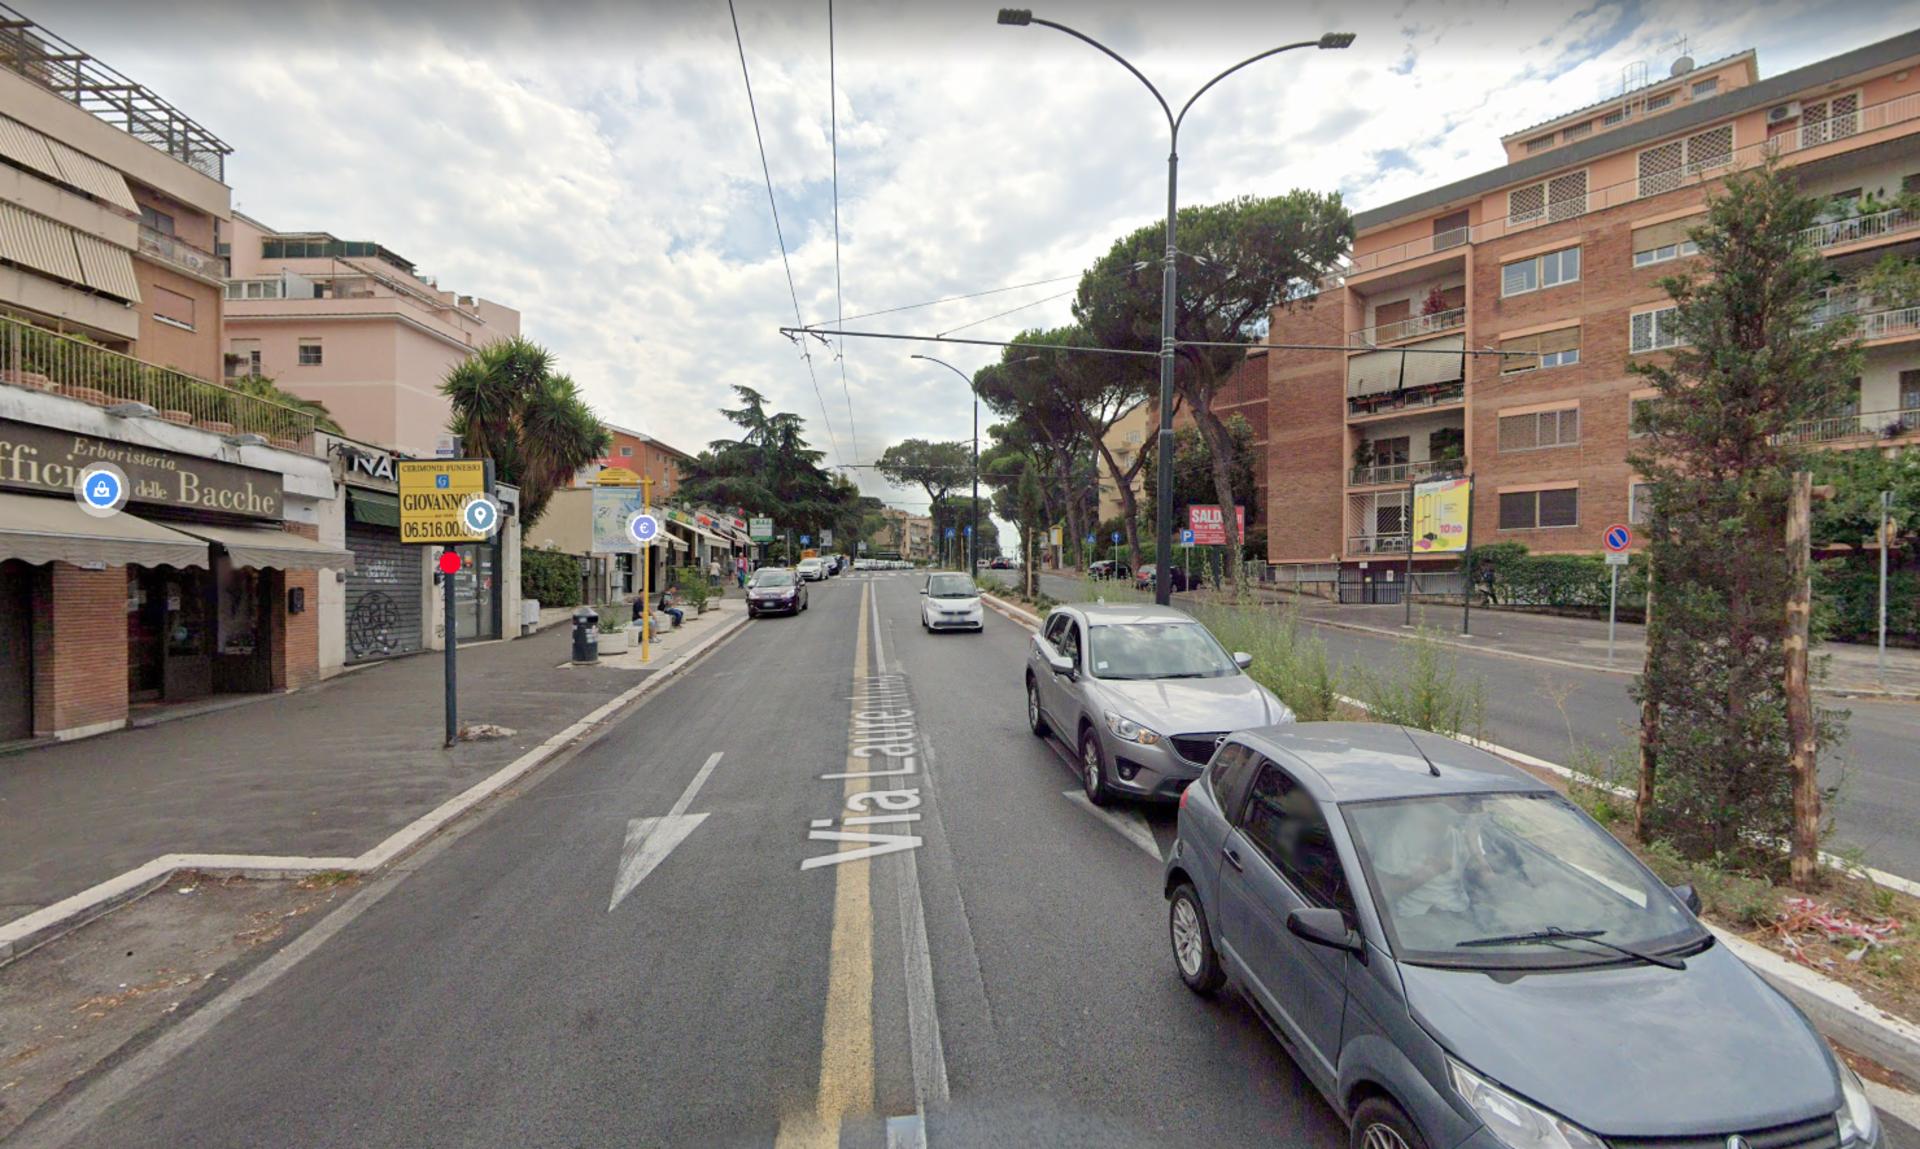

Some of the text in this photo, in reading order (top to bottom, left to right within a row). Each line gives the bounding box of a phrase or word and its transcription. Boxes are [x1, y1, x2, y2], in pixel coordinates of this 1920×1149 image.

[73, 437, 176, 471] Erboristeria
[402, 463, 480, 472] CERIMONIE FUNEBRI
[135, 479, 168, 500] delle
[1191, 510, 1225, 523] SALD
[1184, 531, 1192, 542] P
